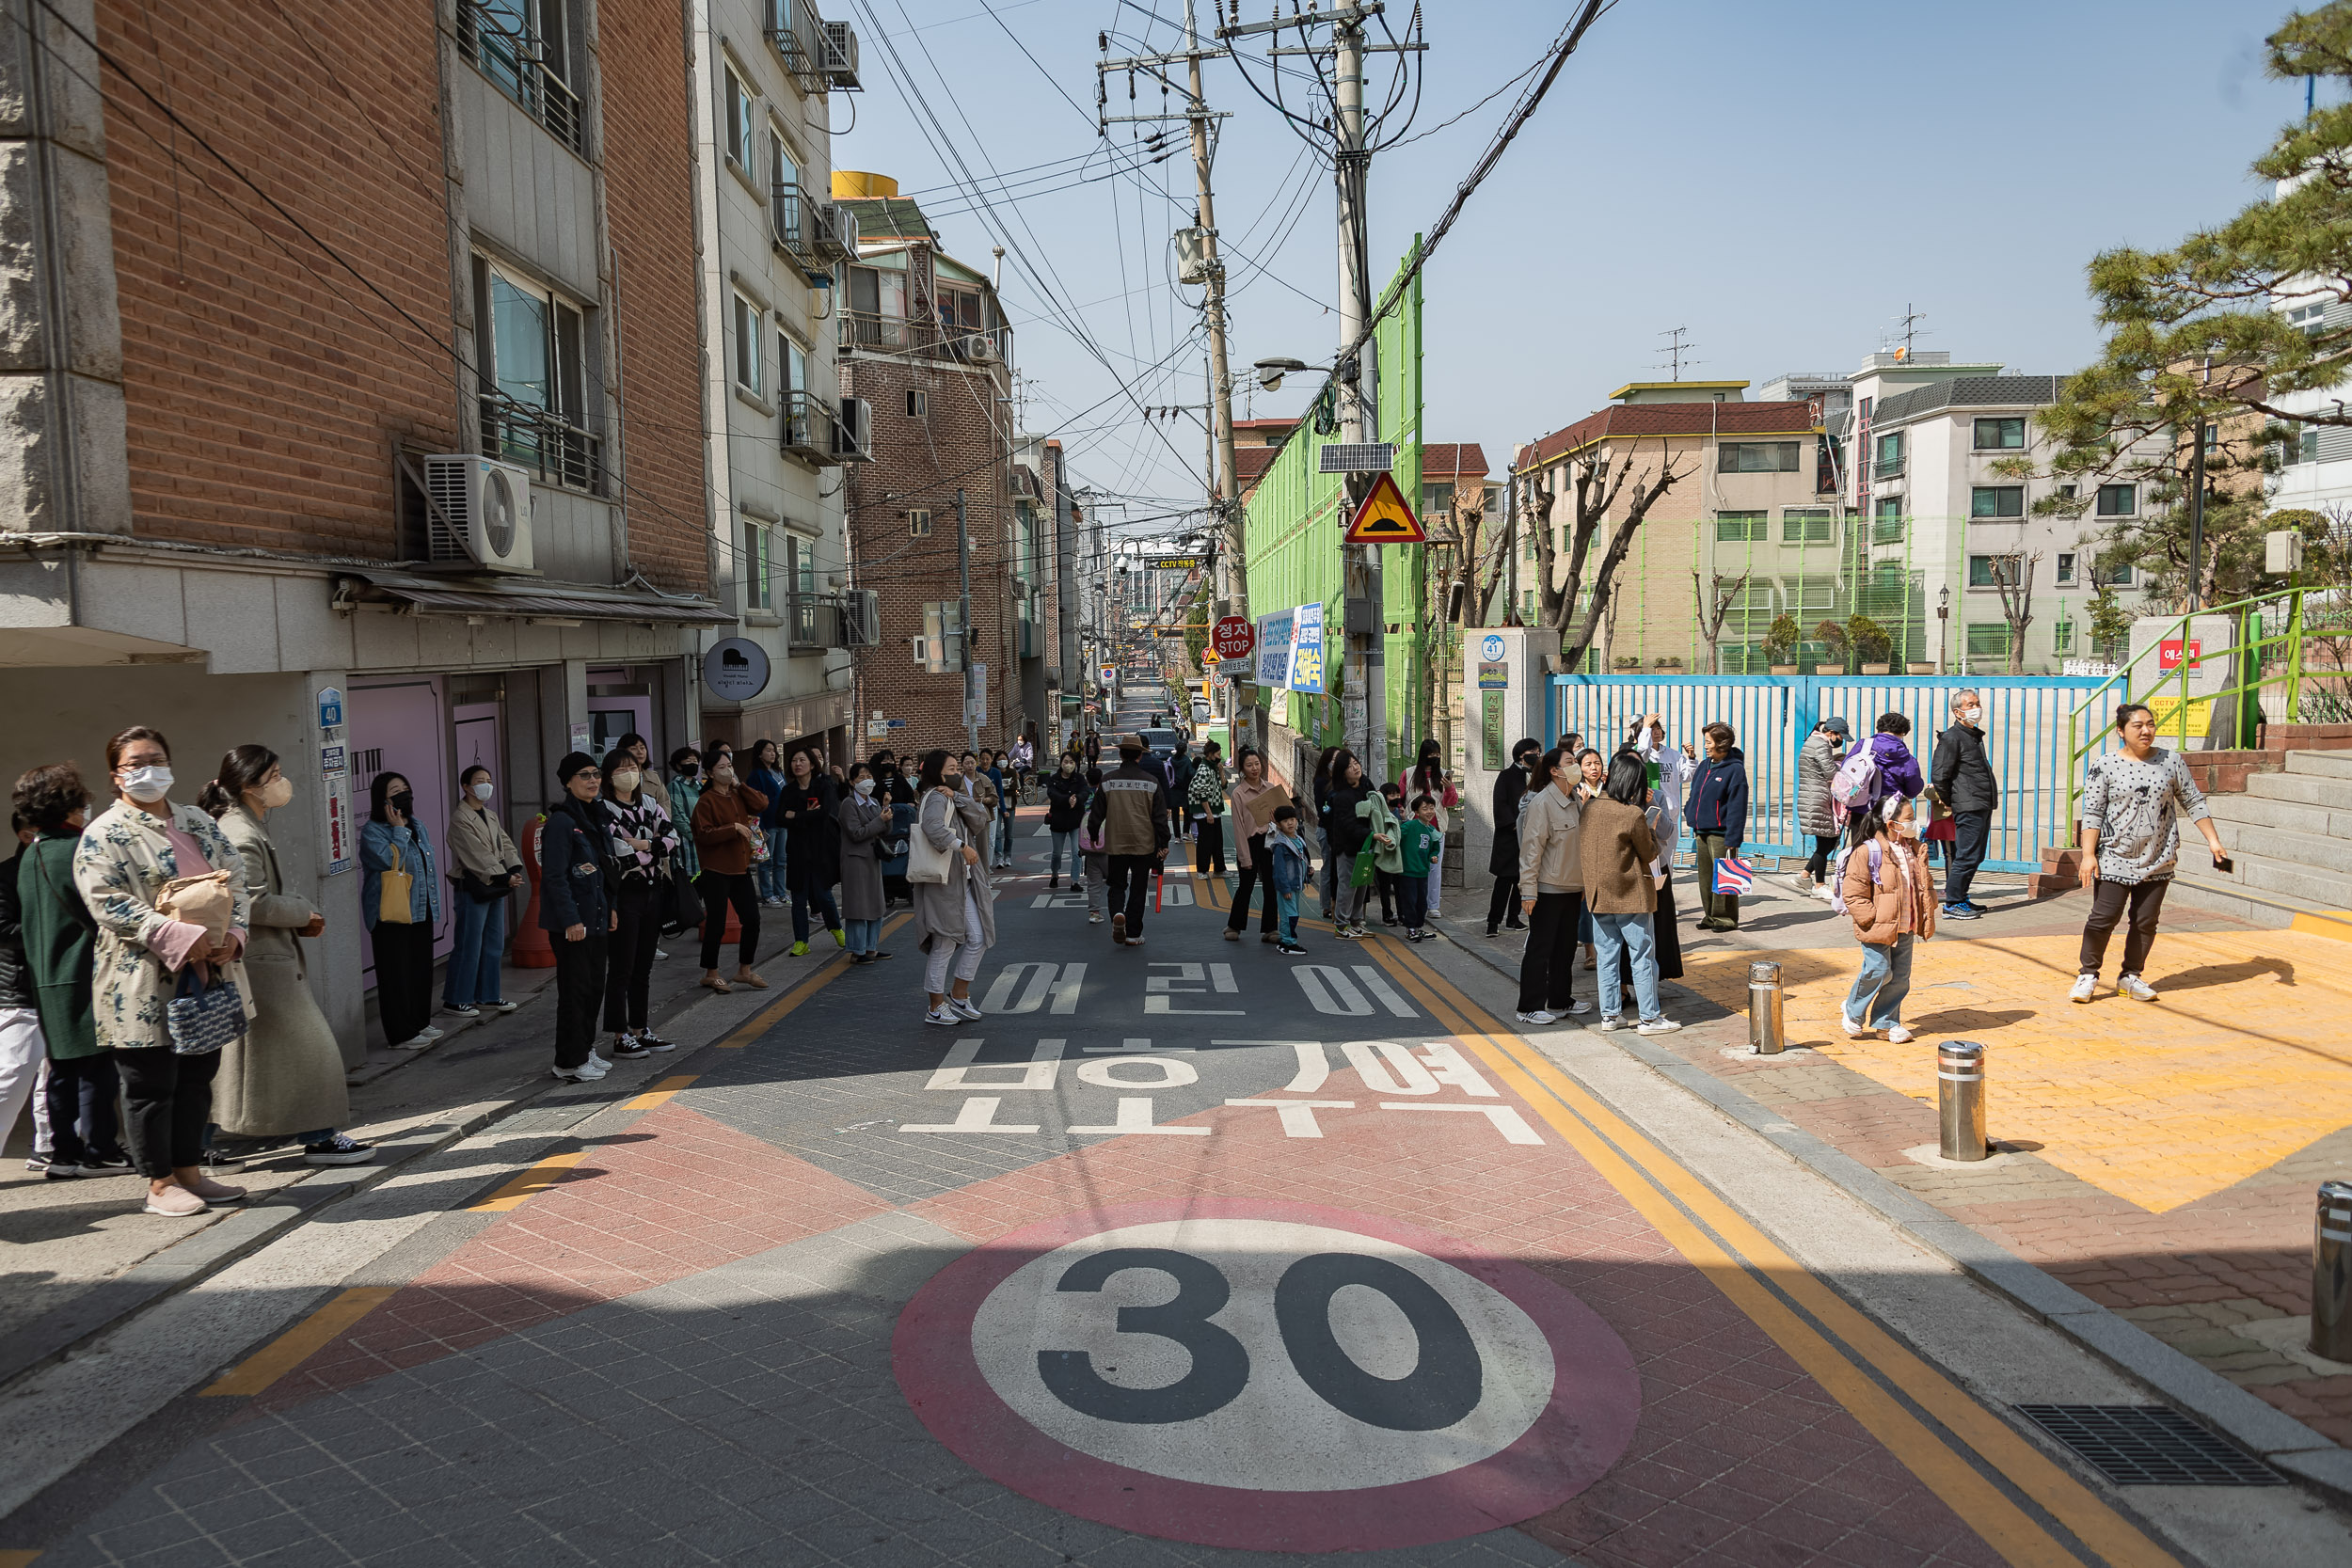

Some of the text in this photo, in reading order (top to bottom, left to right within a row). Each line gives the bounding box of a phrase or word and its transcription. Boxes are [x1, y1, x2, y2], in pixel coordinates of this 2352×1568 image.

[520, 505, 528, 517] LG
[1178, 559, 1196, 568] 작동중
[1217, 622, 1248, 639] 정지
[1218, 640, 1249, 654] STOP
[1486, 644, 1498, 654] 41
[1294, 647, 1321, 688] 전혜숙
[326, 707, 337, 722] 40
[324, 755, 342, 769] 주차금지
[980, 962, 1420, 1018] 어린이
[898, 1037, 1546, 1145] 보호구역
[1038, 1247, 1483, 1433] 30
